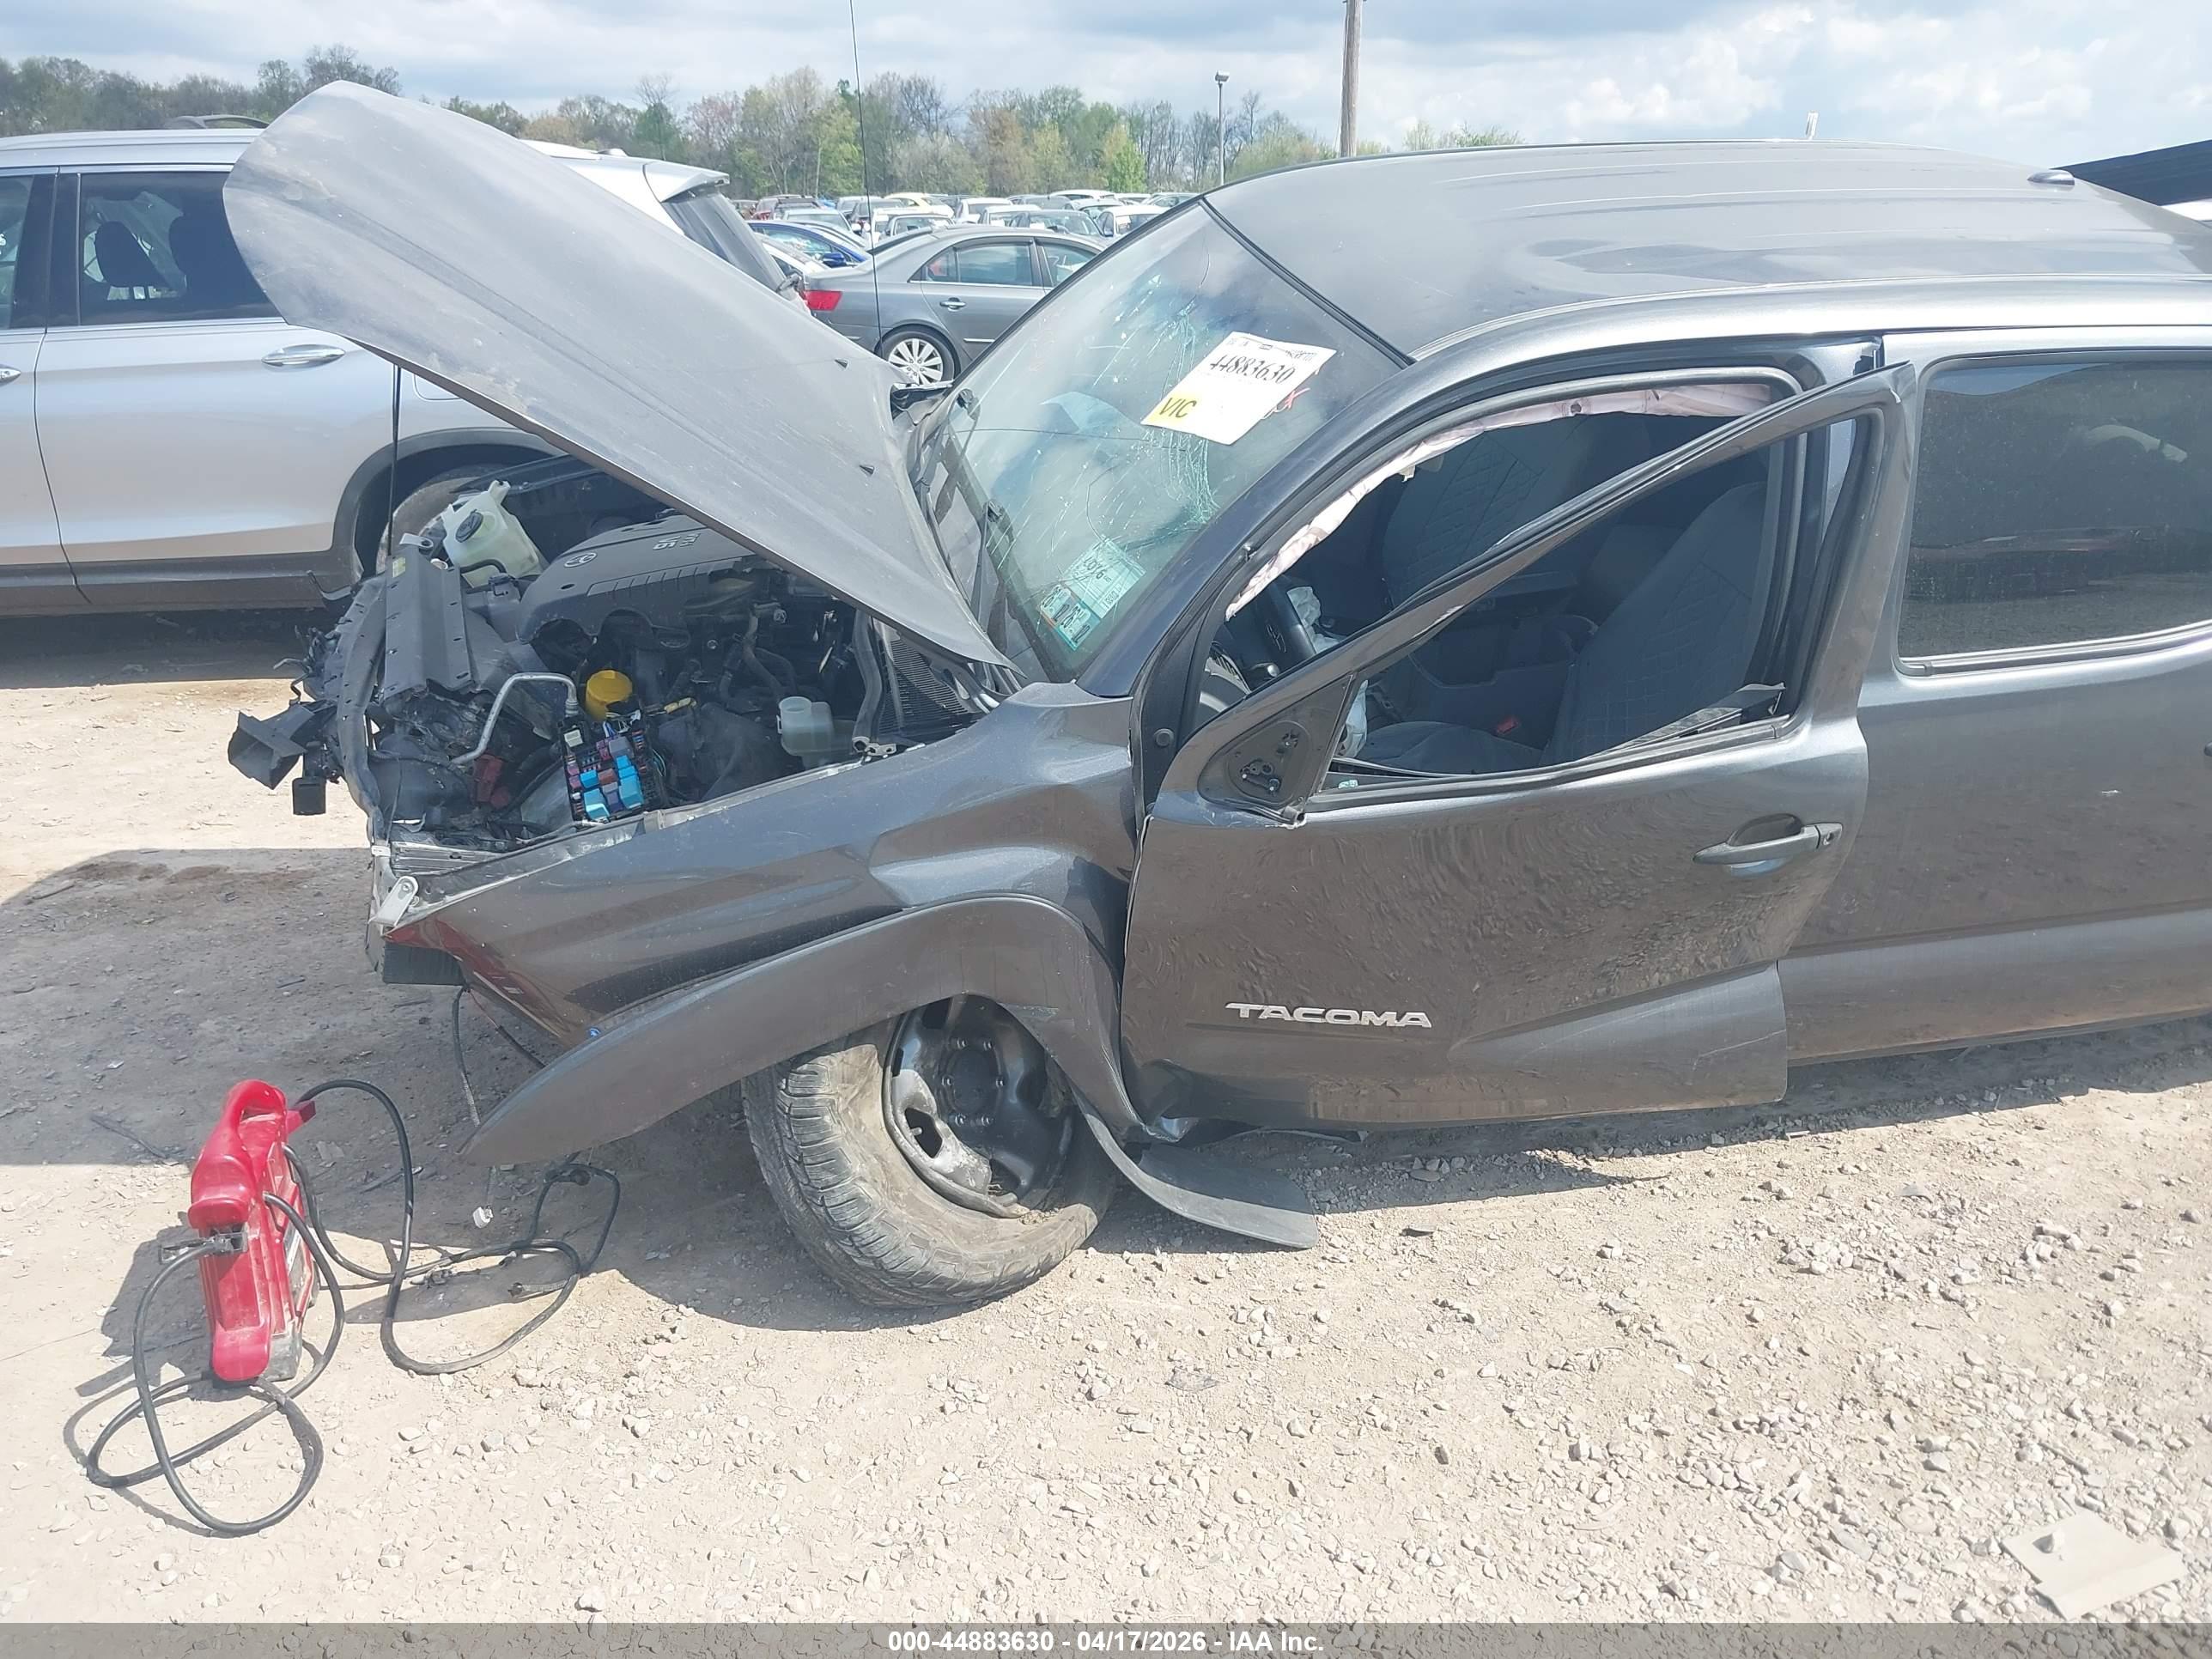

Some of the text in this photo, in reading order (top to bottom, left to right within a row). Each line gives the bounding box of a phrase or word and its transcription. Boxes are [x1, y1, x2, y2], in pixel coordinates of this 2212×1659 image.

[1210, 355, 1295, 383] 44883630
[1159, 398, 1197, 418] VIC
[1225, 1003, 1432, 1028] TACOMA
